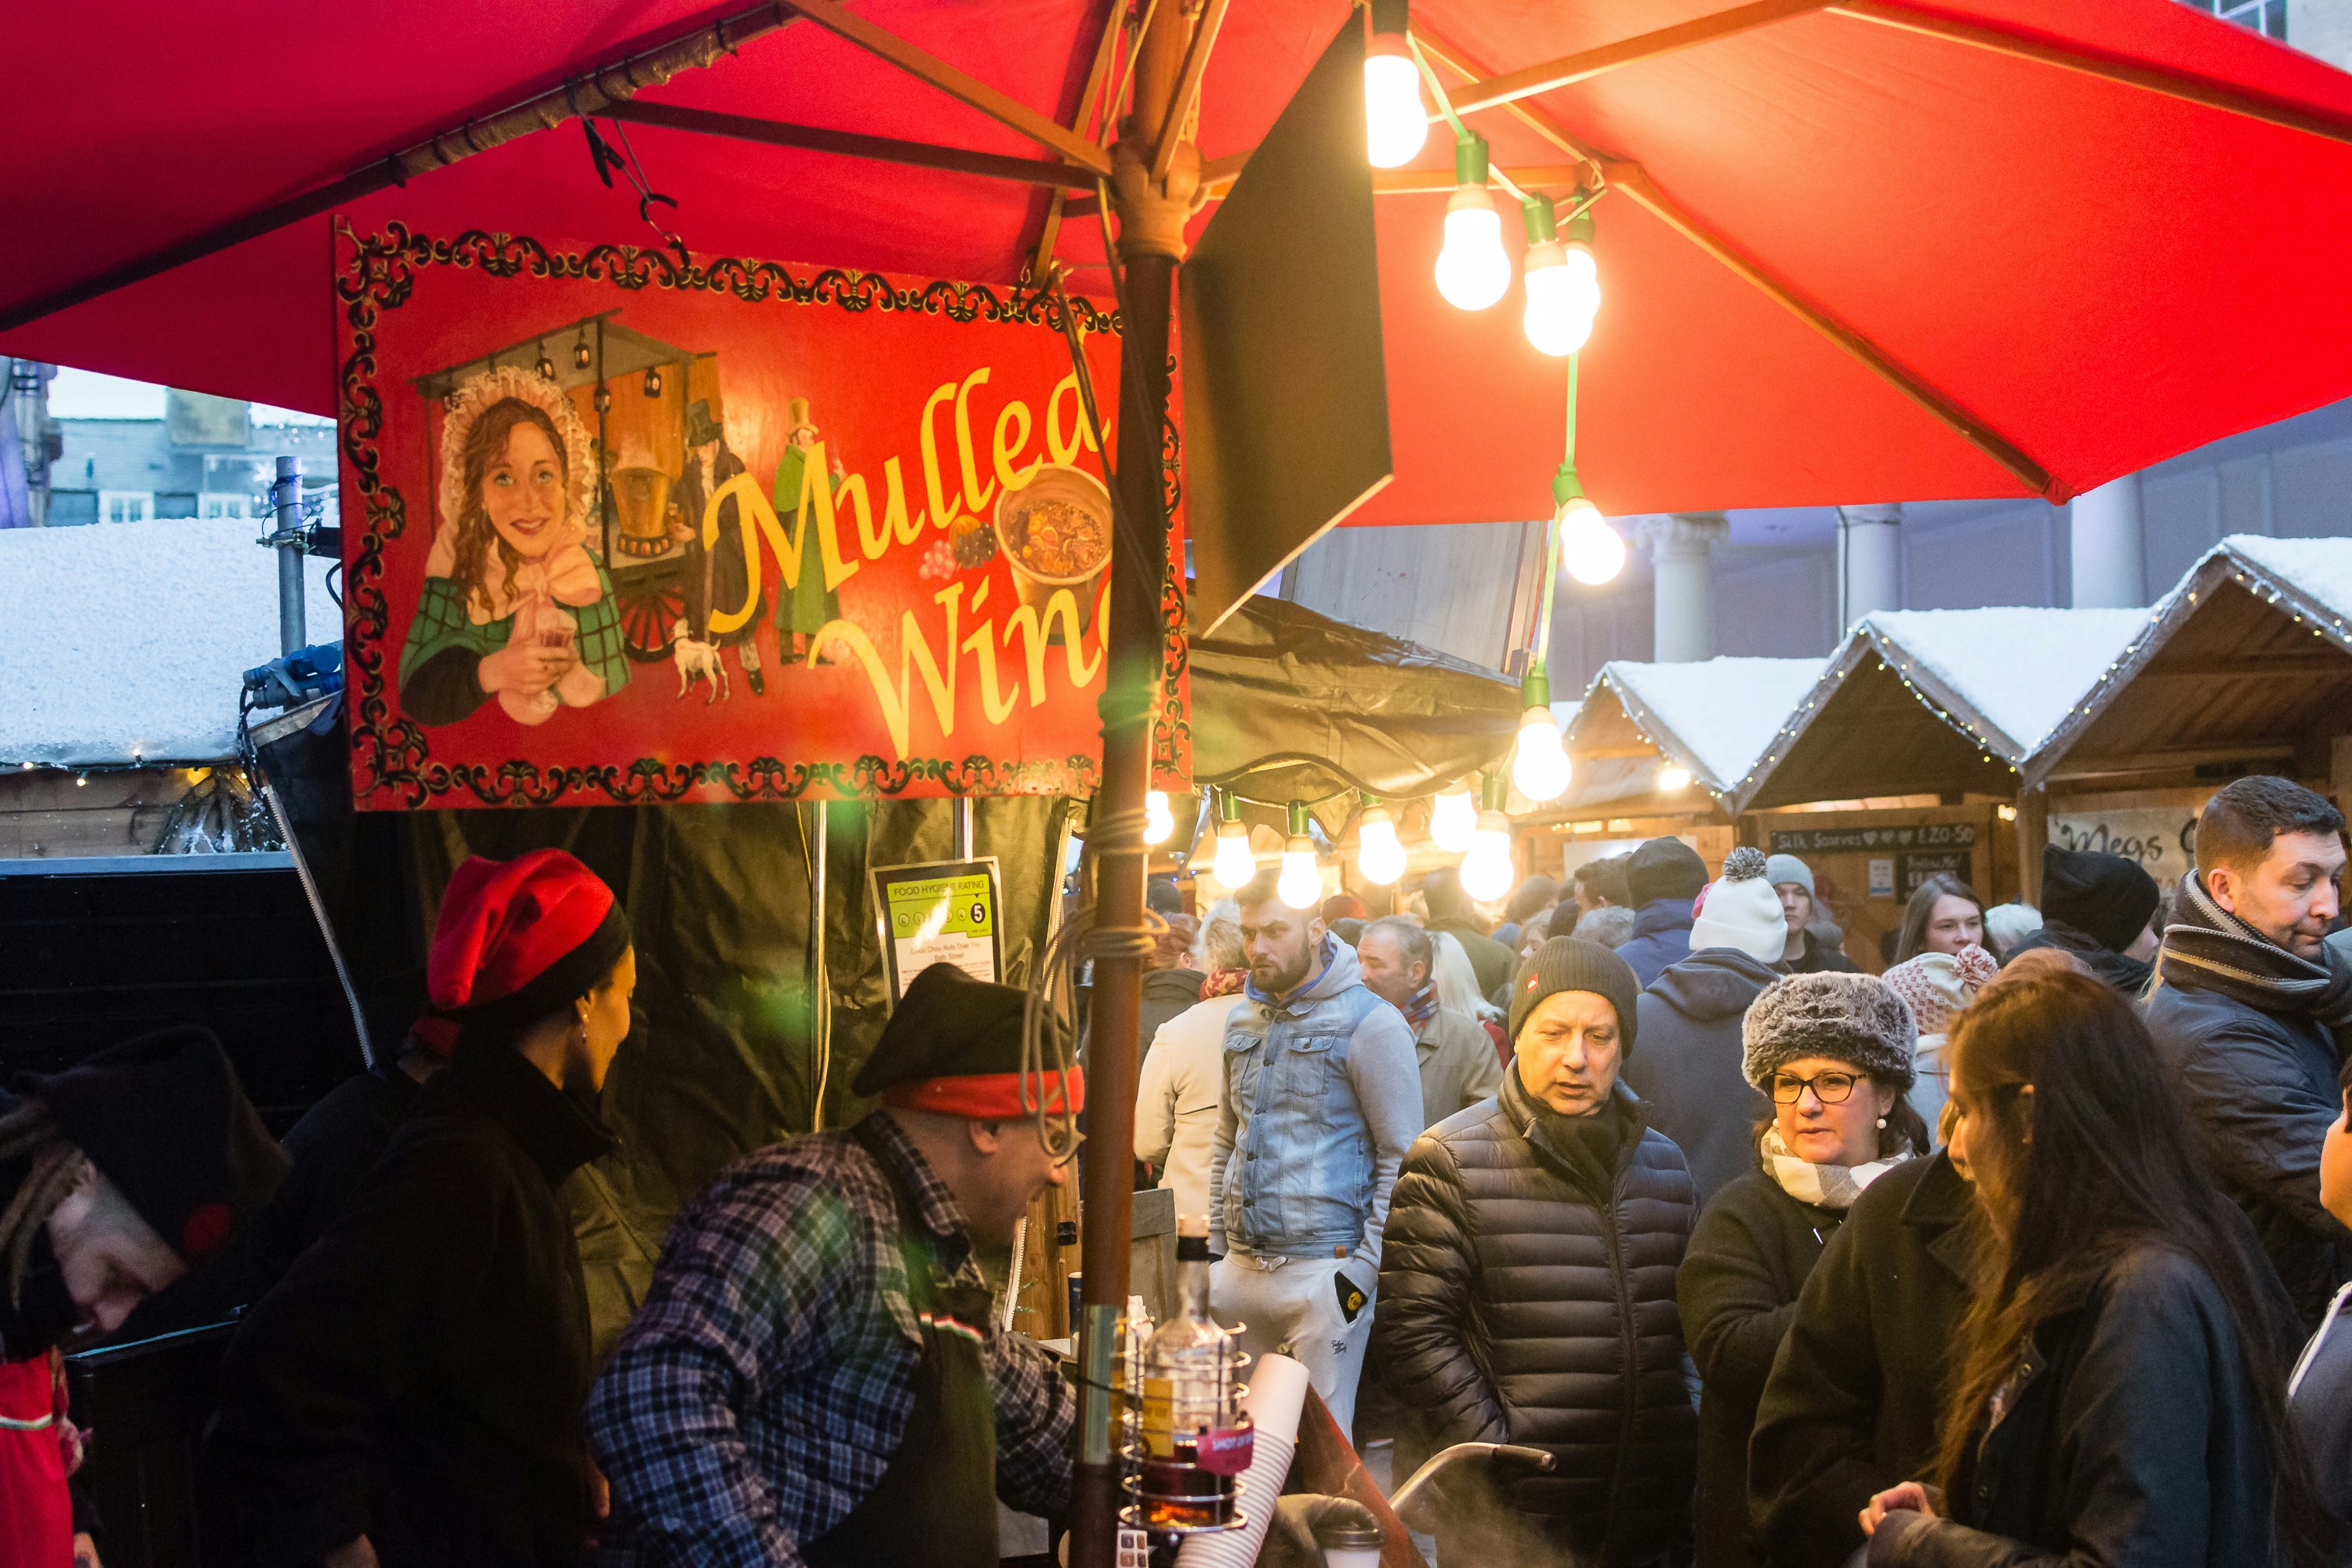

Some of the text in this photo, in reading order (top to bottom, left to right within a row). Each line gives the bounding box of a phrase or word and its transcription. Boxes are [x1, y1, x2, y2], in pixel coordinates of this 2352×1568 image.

[704, 317, 1111, 633] Mulled
[808, 575, 1109, 760] Win
[894, 886, 920, 896] FOOD
[957, 880, 984, 890] RATING
[974, 905, 983, 922] 5
